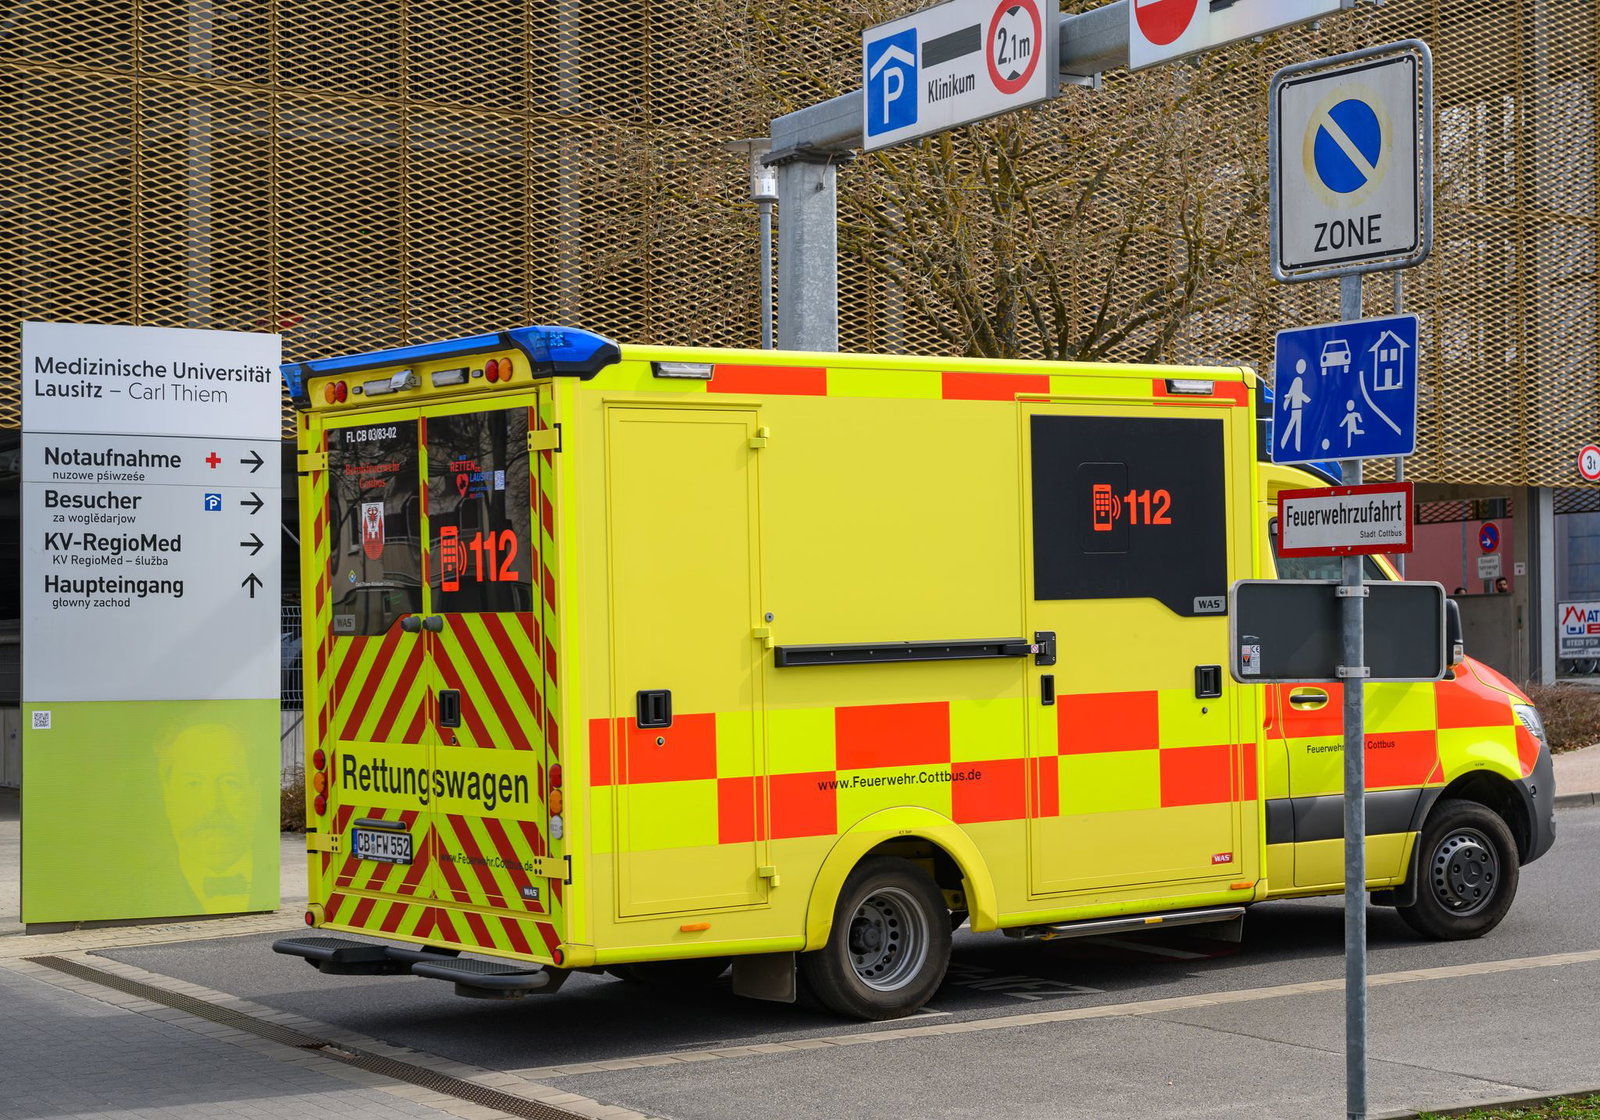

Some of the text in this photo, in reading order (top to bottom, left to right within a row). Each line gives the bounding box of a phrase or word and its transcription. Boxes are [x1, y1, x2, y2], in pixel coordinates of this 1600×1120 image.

[928, 73, 975, 103] Klinikum
[1314, 213, 1382, 253] ZONE
[35, 356, 272, 383] Medizinische Universität
[35, 379, 103, 398] Lausitz
[128, 382, 165, 401] Carl
[171, 383, 228, 403] Thiem
[346, 426, 397, 443] FL CB 03/83-02
[45, 446, 181, 468] Notaufnahme
[1587, 455, 1596, 470] 3t
[52, 470, 145, 482] nuzowe pśiwześe
[45, 489, 142, 509] Besucher
[1124, 489, 1172, 525] 112
[53, 513, 136, 525] za woglědarjow
[1286, 500, 1402, 527] Feuerwehrzufahrt
[45, 532, 181, 555] KV-RegioMed
[1360, 529, 1402, 538] Stadt Cottbus
[53, 555, 68, 564] KV
[71, 555, 123, 567] RegioMed
[469, 529, 519, 583] 112
[45, 575, 184, 598] Haupteingang
[93, 598, 131, 607] zachod
[1198, 600, 1220, 609] WAS
[336, 618, 353, 628] WAS
[1367, 740, 1396, 749] Cottbus
[342, 754, 529, 811] Rettungswagen
[817, 769, 982, 791] www.Feuerwehr.Cottbus.de
[358, 833, 410, 857] CB FW 552
[1214, 854, 1230, 862] WAS
[523, 888, 537, 897] WAS
